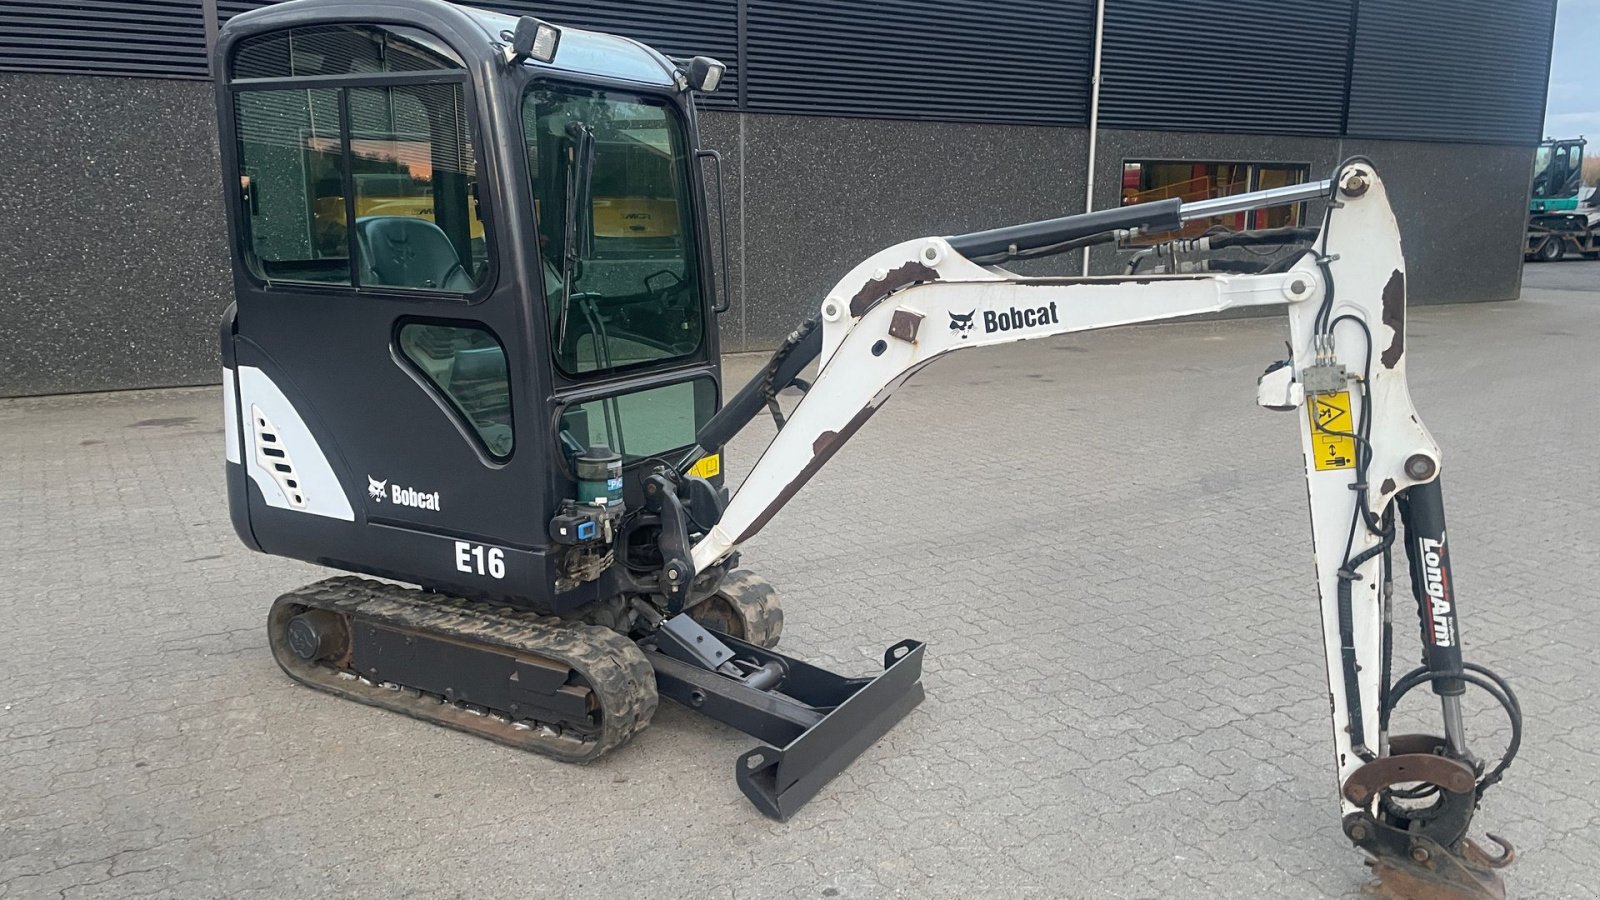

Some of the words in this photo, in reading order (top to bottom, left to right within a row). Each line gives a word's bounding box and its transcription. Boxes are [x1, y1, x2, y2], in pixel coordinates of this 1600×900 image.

[983, 301, 1059, 333] Bobcat
[391, 484, 441, 512] Bobcat
[455, 541, 506, 579] E16
[1421, 533, 1451, 647] LongArm
